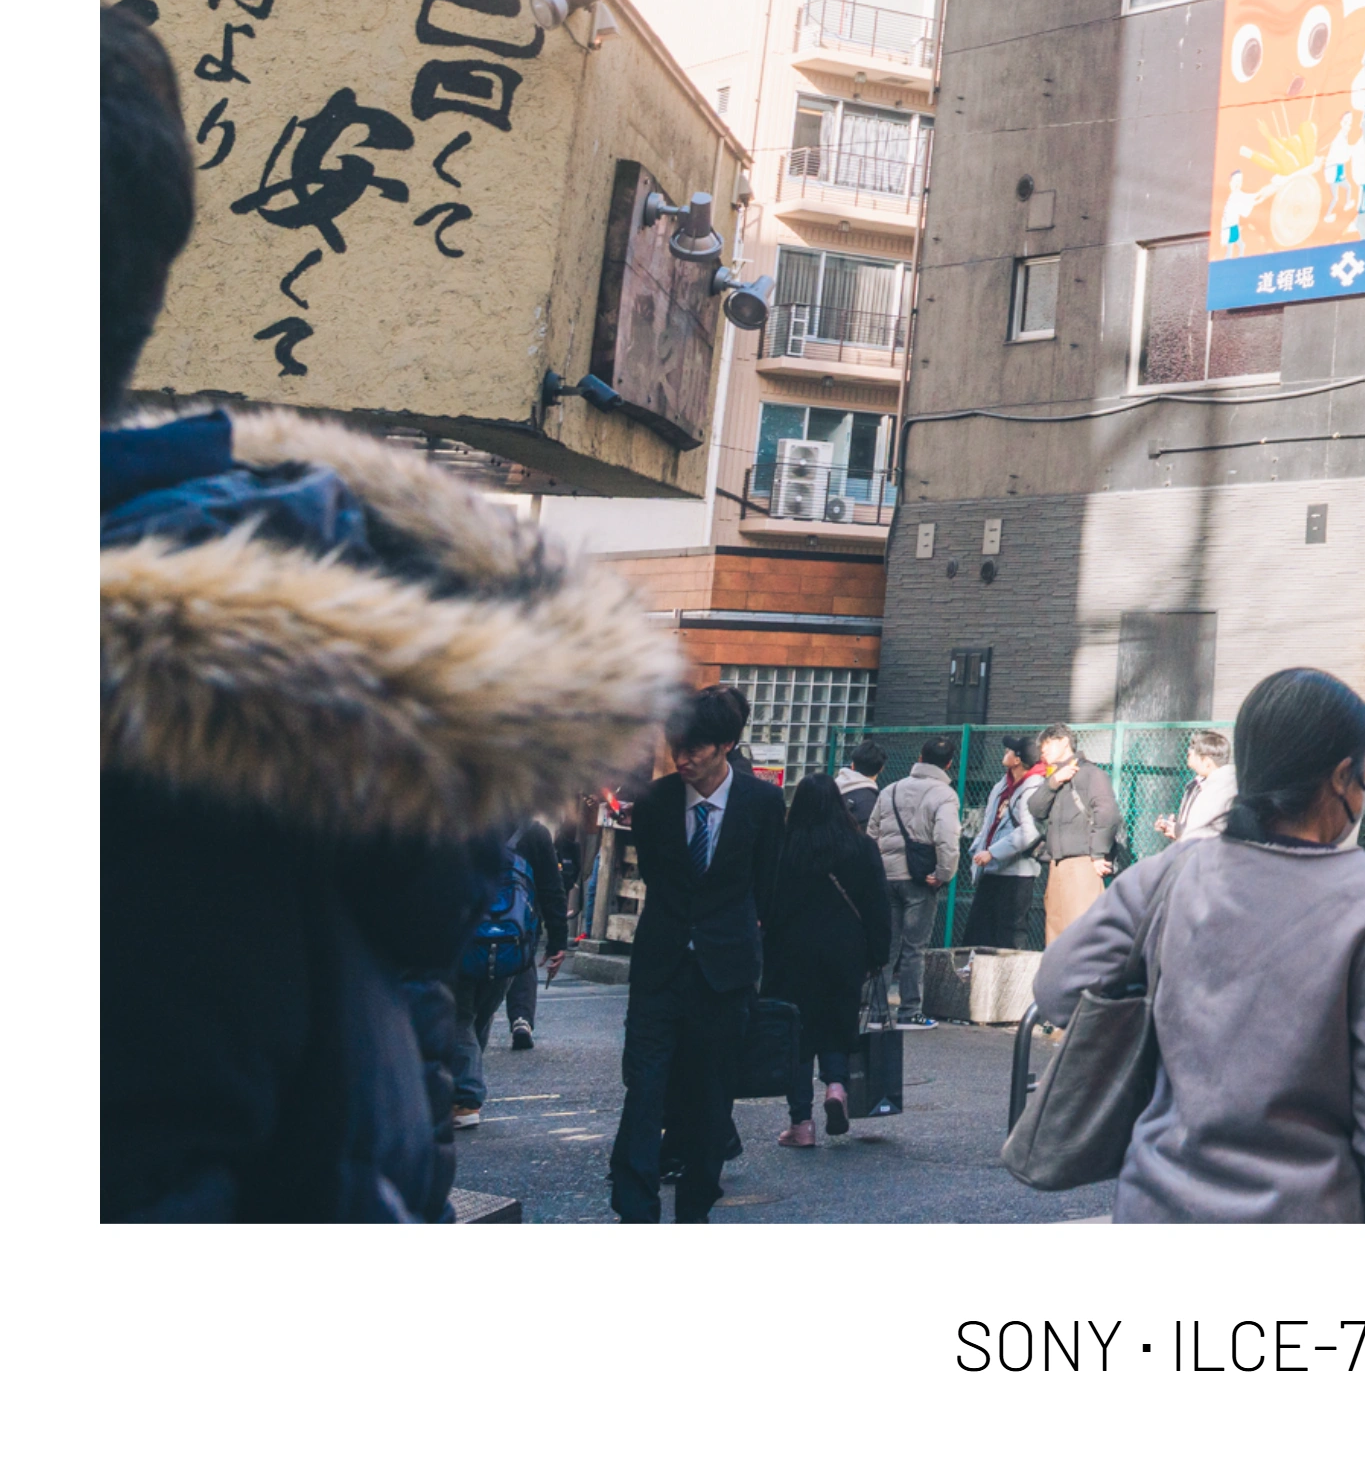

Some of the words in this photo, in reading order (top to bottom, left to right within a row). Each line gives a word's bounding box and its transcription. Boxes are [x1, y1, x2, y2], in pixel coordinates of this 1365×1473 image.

[231, 87, 415, 377] 安くて
[1256, 266, 1315, 295] 道頓堀
